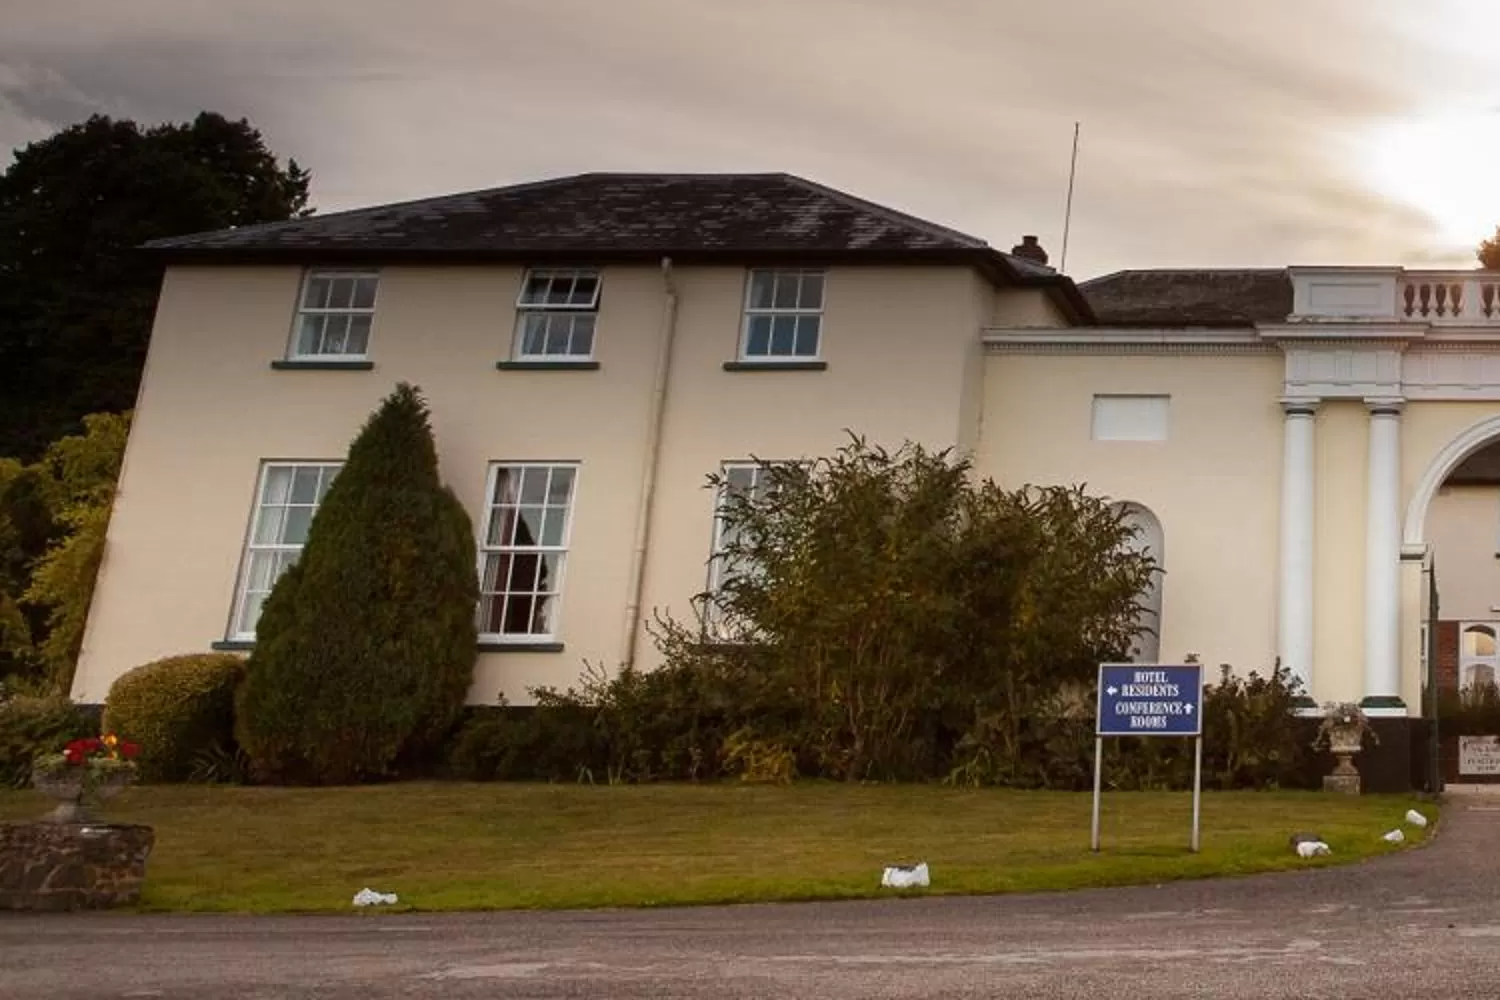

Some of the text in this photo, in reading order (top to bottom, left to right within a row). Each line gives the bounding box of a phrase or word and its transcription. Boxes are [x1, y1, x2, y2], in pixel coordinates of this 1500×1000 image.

[1134, 671, 1168, 683] HOTEL
[1121, 684, 1179, 697] RESIDENTS
[1115, 701, 1182, 715] CONFERENCE
[1130, 716, 1167, 728] ROOMS
